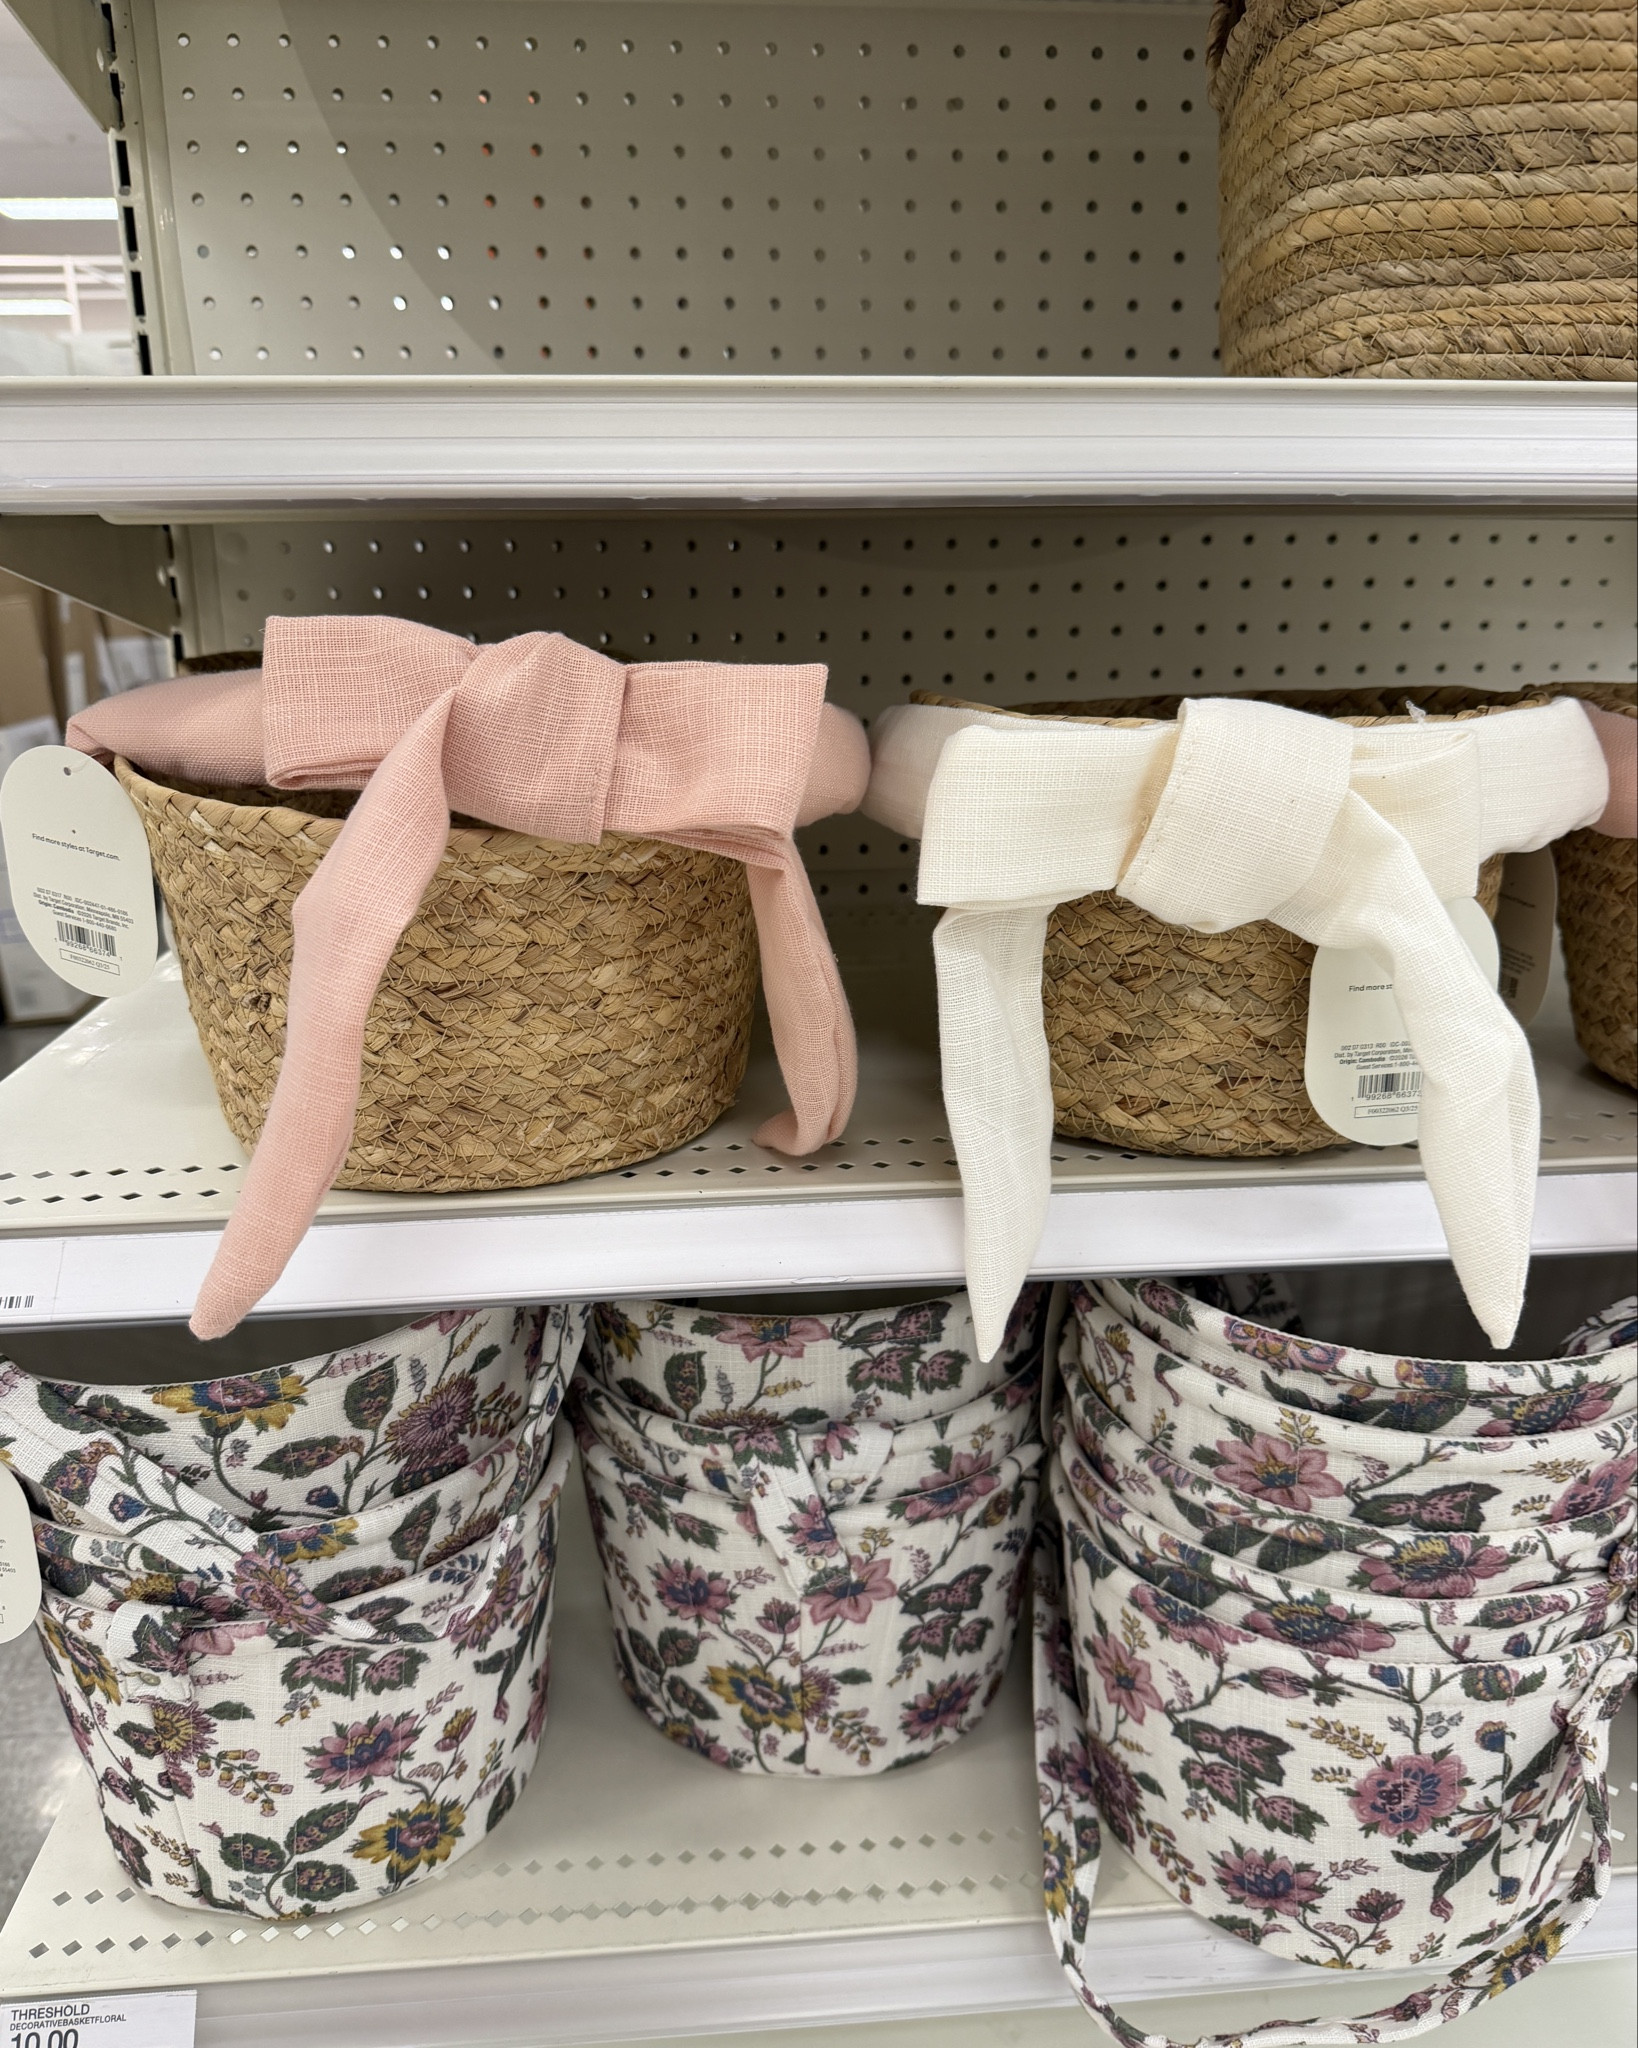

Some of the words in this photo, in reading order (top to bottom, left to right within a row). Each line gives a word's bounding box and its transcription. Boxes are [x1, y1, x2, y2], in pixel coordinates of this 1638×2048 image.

[32, 832, 45, 842] Find
[45, 837, 61, 846] more
[61, 840, 78, 851] styles
[86, 846, 121, 861] Target.com.
[1348, 984, 1365, 992] Find
[1365, 983, 1385, 991] more
[1354, 1049, 1370, 1057] Target
[1366, 1092, 1392, 1101] 99268
[11, 2003, 91, 2021] THRESHOLD
[10, 2013, 127, 2031] DECORATIVEBASKETFLORAL
[10, 2028, 79, 2048] 1000
